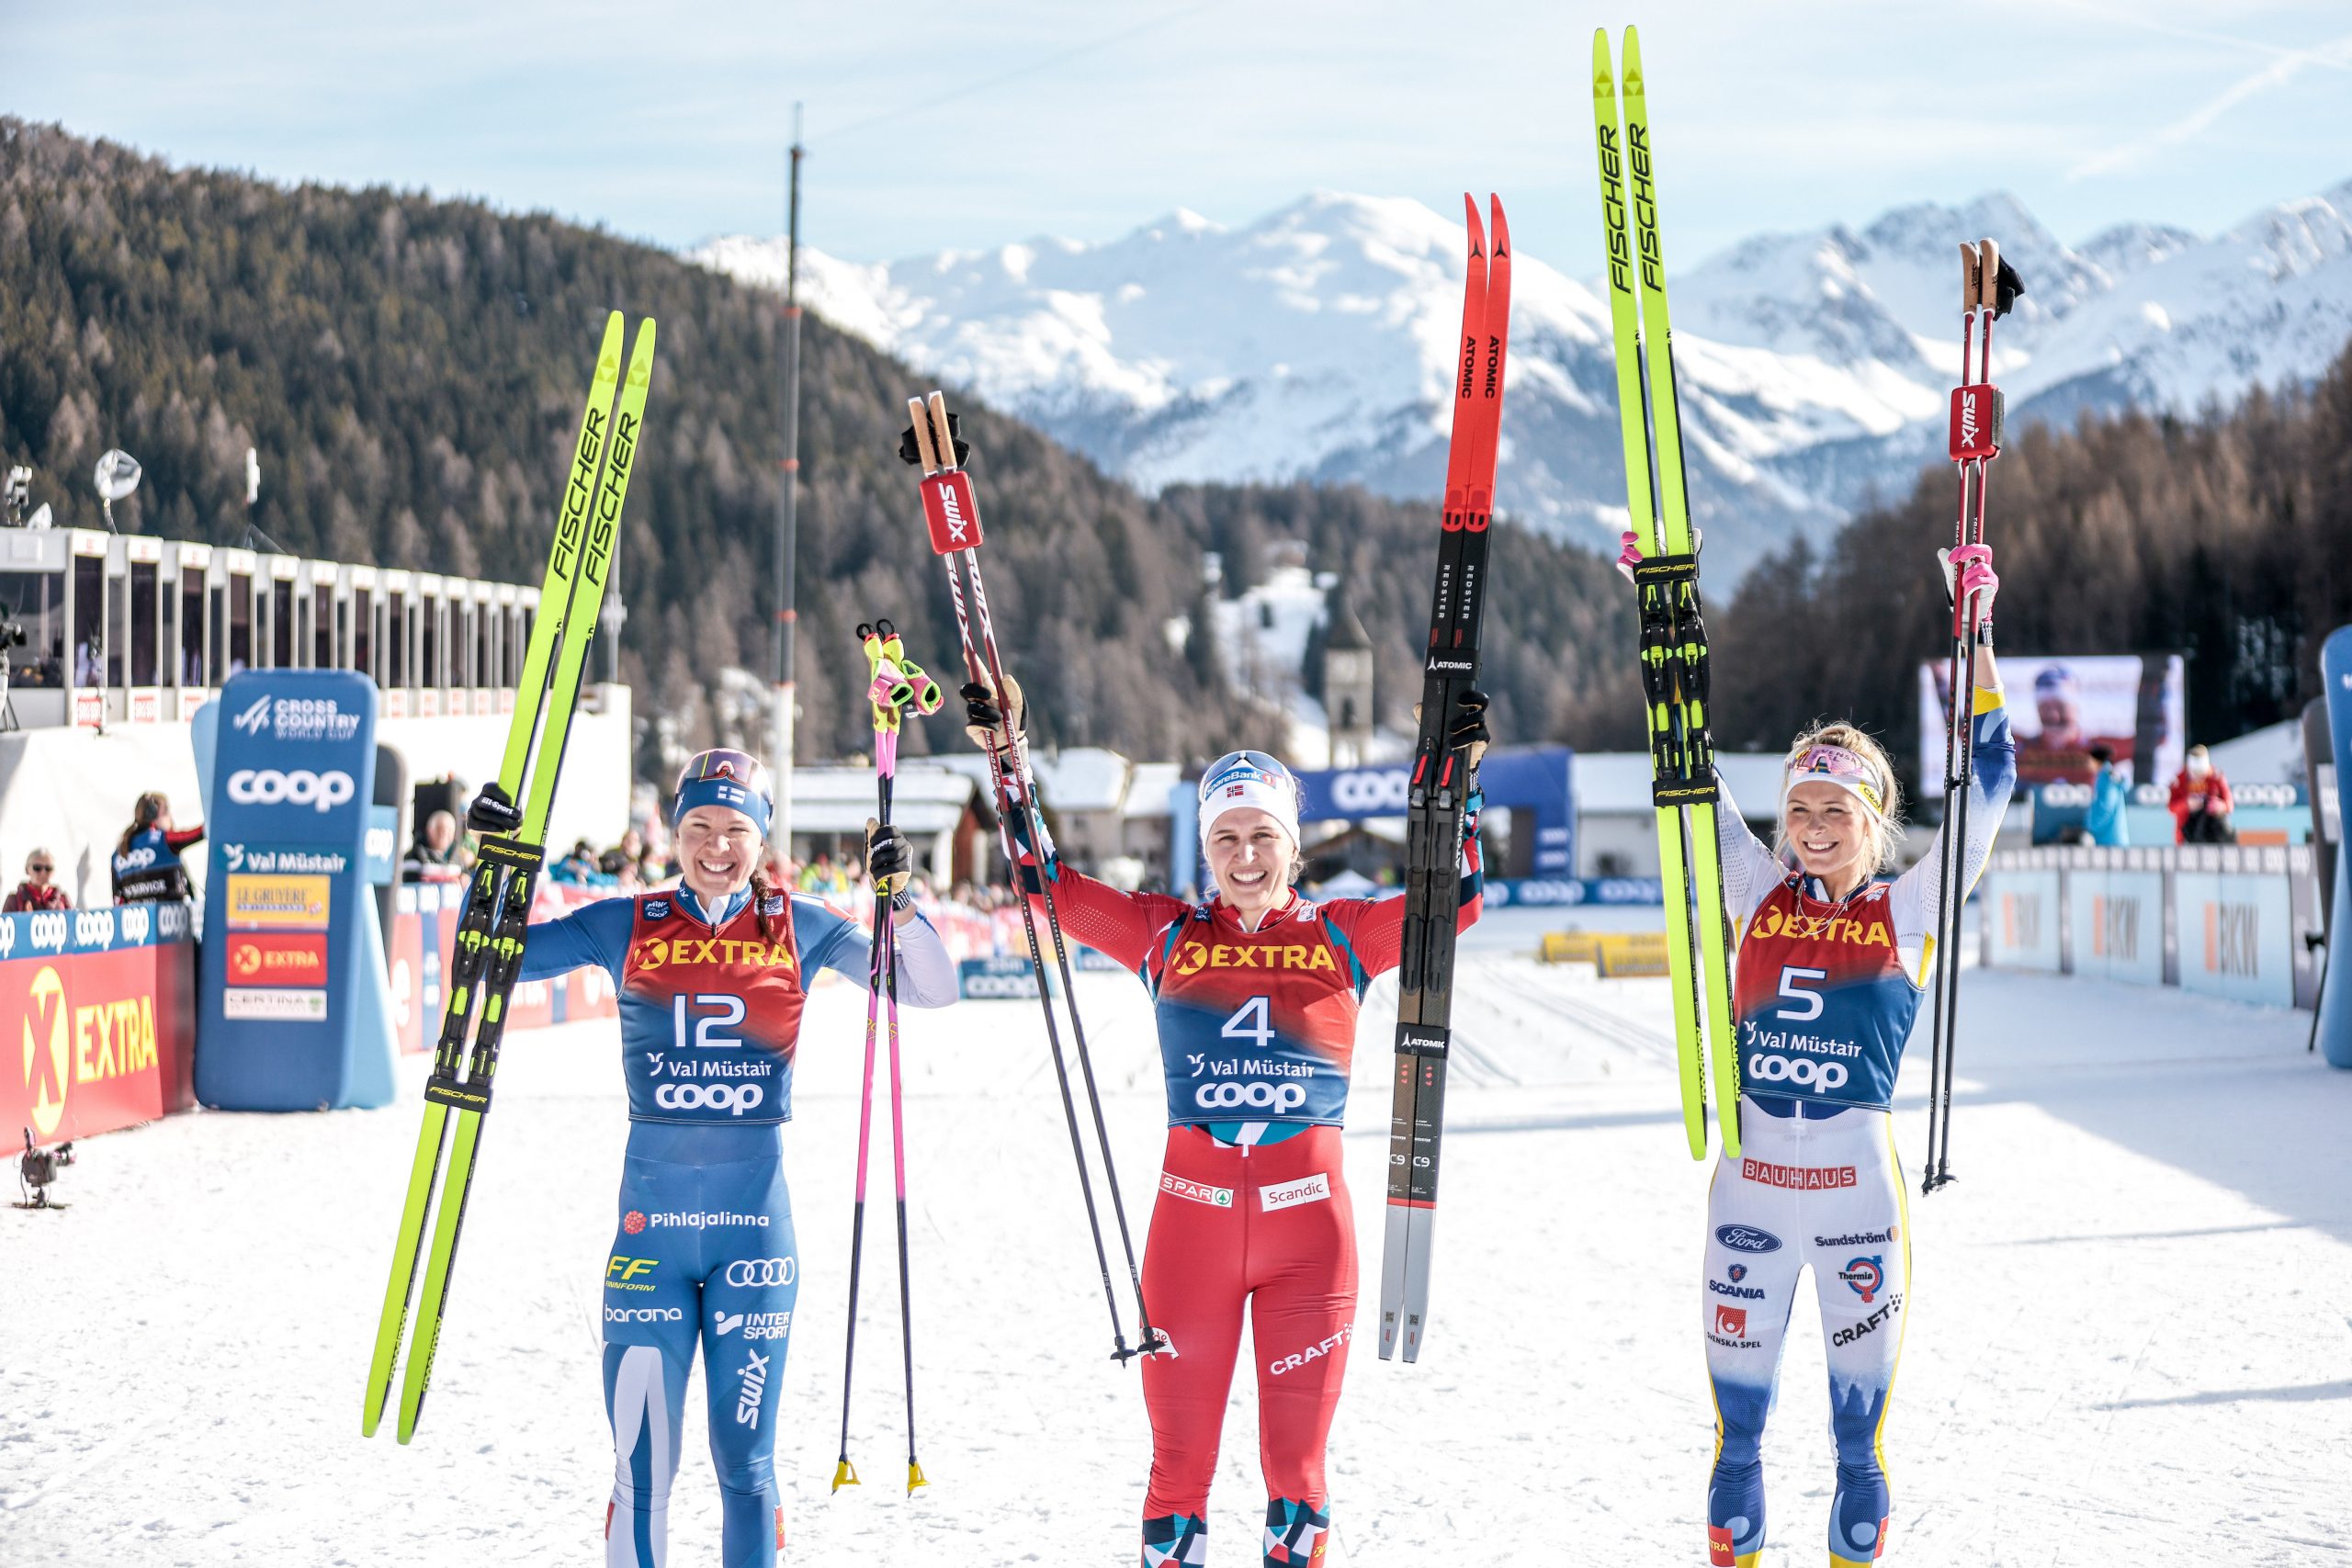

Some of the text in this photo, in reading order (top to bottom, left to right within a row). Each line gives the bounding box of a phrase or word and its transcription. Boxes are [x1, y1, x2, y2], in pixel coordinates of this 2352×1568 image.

[1600, 124, 1631, 294] FISCHER
[1629, 122, 1663, 293] FISCHER
[1462, 335, 1476, 400] ATOMIC
[1485, 334, 1499, 399] ATOMIC
[553, 407, 605, 581] FISCHER
[585, 412, 638, 587] FISCHER
[1636, 563, 1695, 575] FISCHER
[1439, 564, 1451, 619] REDSTER
[1463, 565, 1475, 619] REDSTER
[1437, 660, 1473, 671] ATOMIC
[275, 699, 338, 714] CROSS
[275, 714, 361, 728] COUNTRY
[276, 728, 355, 739] WORLD CUP
[985, 730, 993, 750] RIAC
[228, 770, 356, 813] coop
[1332, 770, 1410, 812] coo
[1657, 787, 1716, 797] FISCHER
[2043, 784, 2091, 807] coo
[1454, 806, 1464, 870] ATOMIC
[246, 851, 346, 873] Val Müstair
[482, 844, 542, 862] FISCHER
[30, 913, 67, 954] coop
[75, 910, 115, 951] coop
[1781, 912, 1892, 947] EXTRA
[2219, 902, 2258, 979] BKW
[264, 951, 320, 969] EXTRA
[672, 938, 794, 968] EXTRA
[1211, 944, 1337, 971] EXTRA
[1777, 965, 1827, 1021] 5
[675, 995, 746, 1047] 12
[1221, 996, 1275, 1047] 4
[75, 995, 159, 1085] EXTRA
[1411, 1037, 1445, 1048] ATOMIC
[1759, 1031, 1862, 1058] Val Müstair
[669, 1060, 772, 1077] Val Müstair
[1210, 1059, 1315, 1077] Val Müstair
[1749, 1053, 1849, 1094] coop
[430, 1087, 488, 1103] FISCHER
[655, 1083, 764, 1116] coop
[1195, 1082, 1306, 1114] coop
[1390, 1154, 1406, 1166] C9
[1413, 1156, 1430, 1168] C9
[1744, 1160, 1855, 1189] BAUHAUS
[1162, 1177, 1212, 1200] SPAR
[1269, 1182, 1324, 1204] Scandic
[650, 1212, 770, 1230] Pihlajalinna
[1724, 1227, 1768, 1250] Ford
[1815, 1232, 1886, 1247] Sundström
[606, 1255, 660, 1280] FF
[1838, 1271, 1873, 1281] Thermia
[605, 1280, 657, 1292] FINNFORM
[1709, 1280, 1766, 1300] SCANIA
[605, 1303, 683, 1323] barona
[746, 1311, 791, 1325] INTER
[743, 1325, 789, 1340] SPORT
[1832, 1303, 1891, 1348] CRAFT
[1707, 1331, 1762, 1349] SVENSKA SPEL
[1270, 1330, 1344, 1375] CRAFT
[1709, 1540, 1730, 1552] TRA
